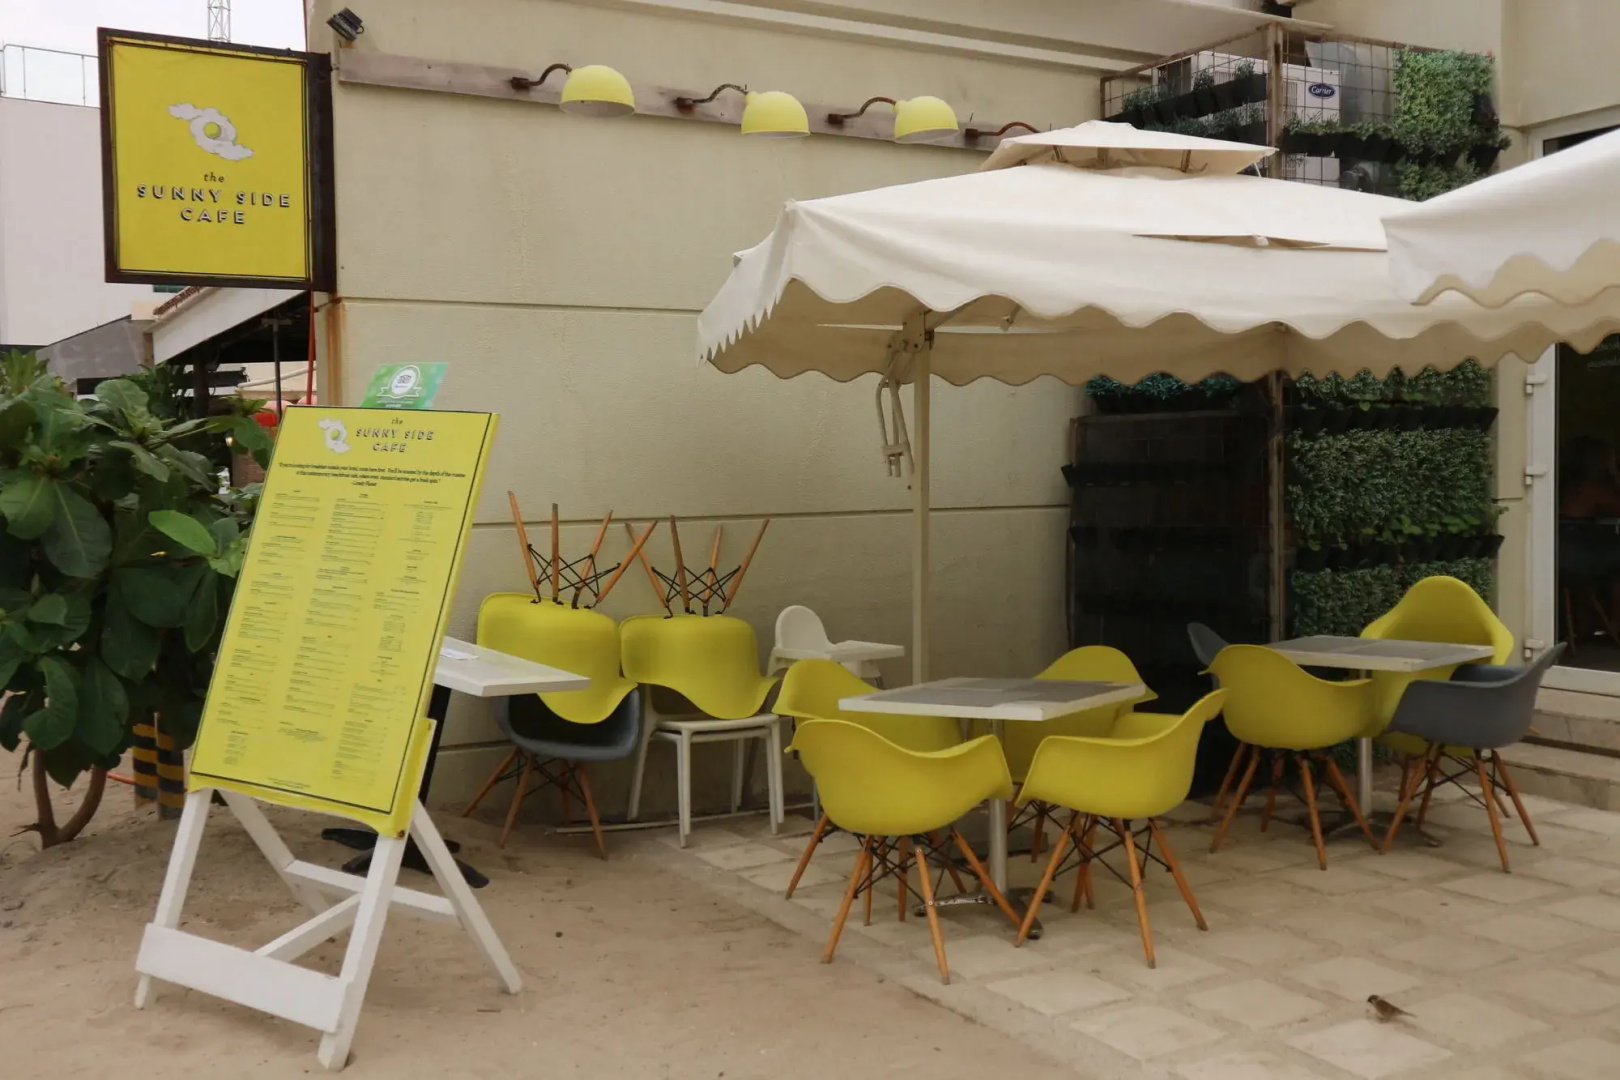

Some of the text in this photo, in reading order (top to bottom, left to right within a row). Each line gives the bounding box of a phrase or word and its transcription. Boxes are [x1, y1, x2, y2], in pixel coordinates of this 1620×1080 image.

[1311, 86, 1332, 95] Carrier
[203, 172, 225, 183] the
[137, 184, 290, 207] SUNNY SIDE
[180, 208, 245, 225] CAFE
[391, 417, 403, 425] the
[355, 428, 434, 441] SUNNY SIDE
[372, 442, 407, 453] CAFE
